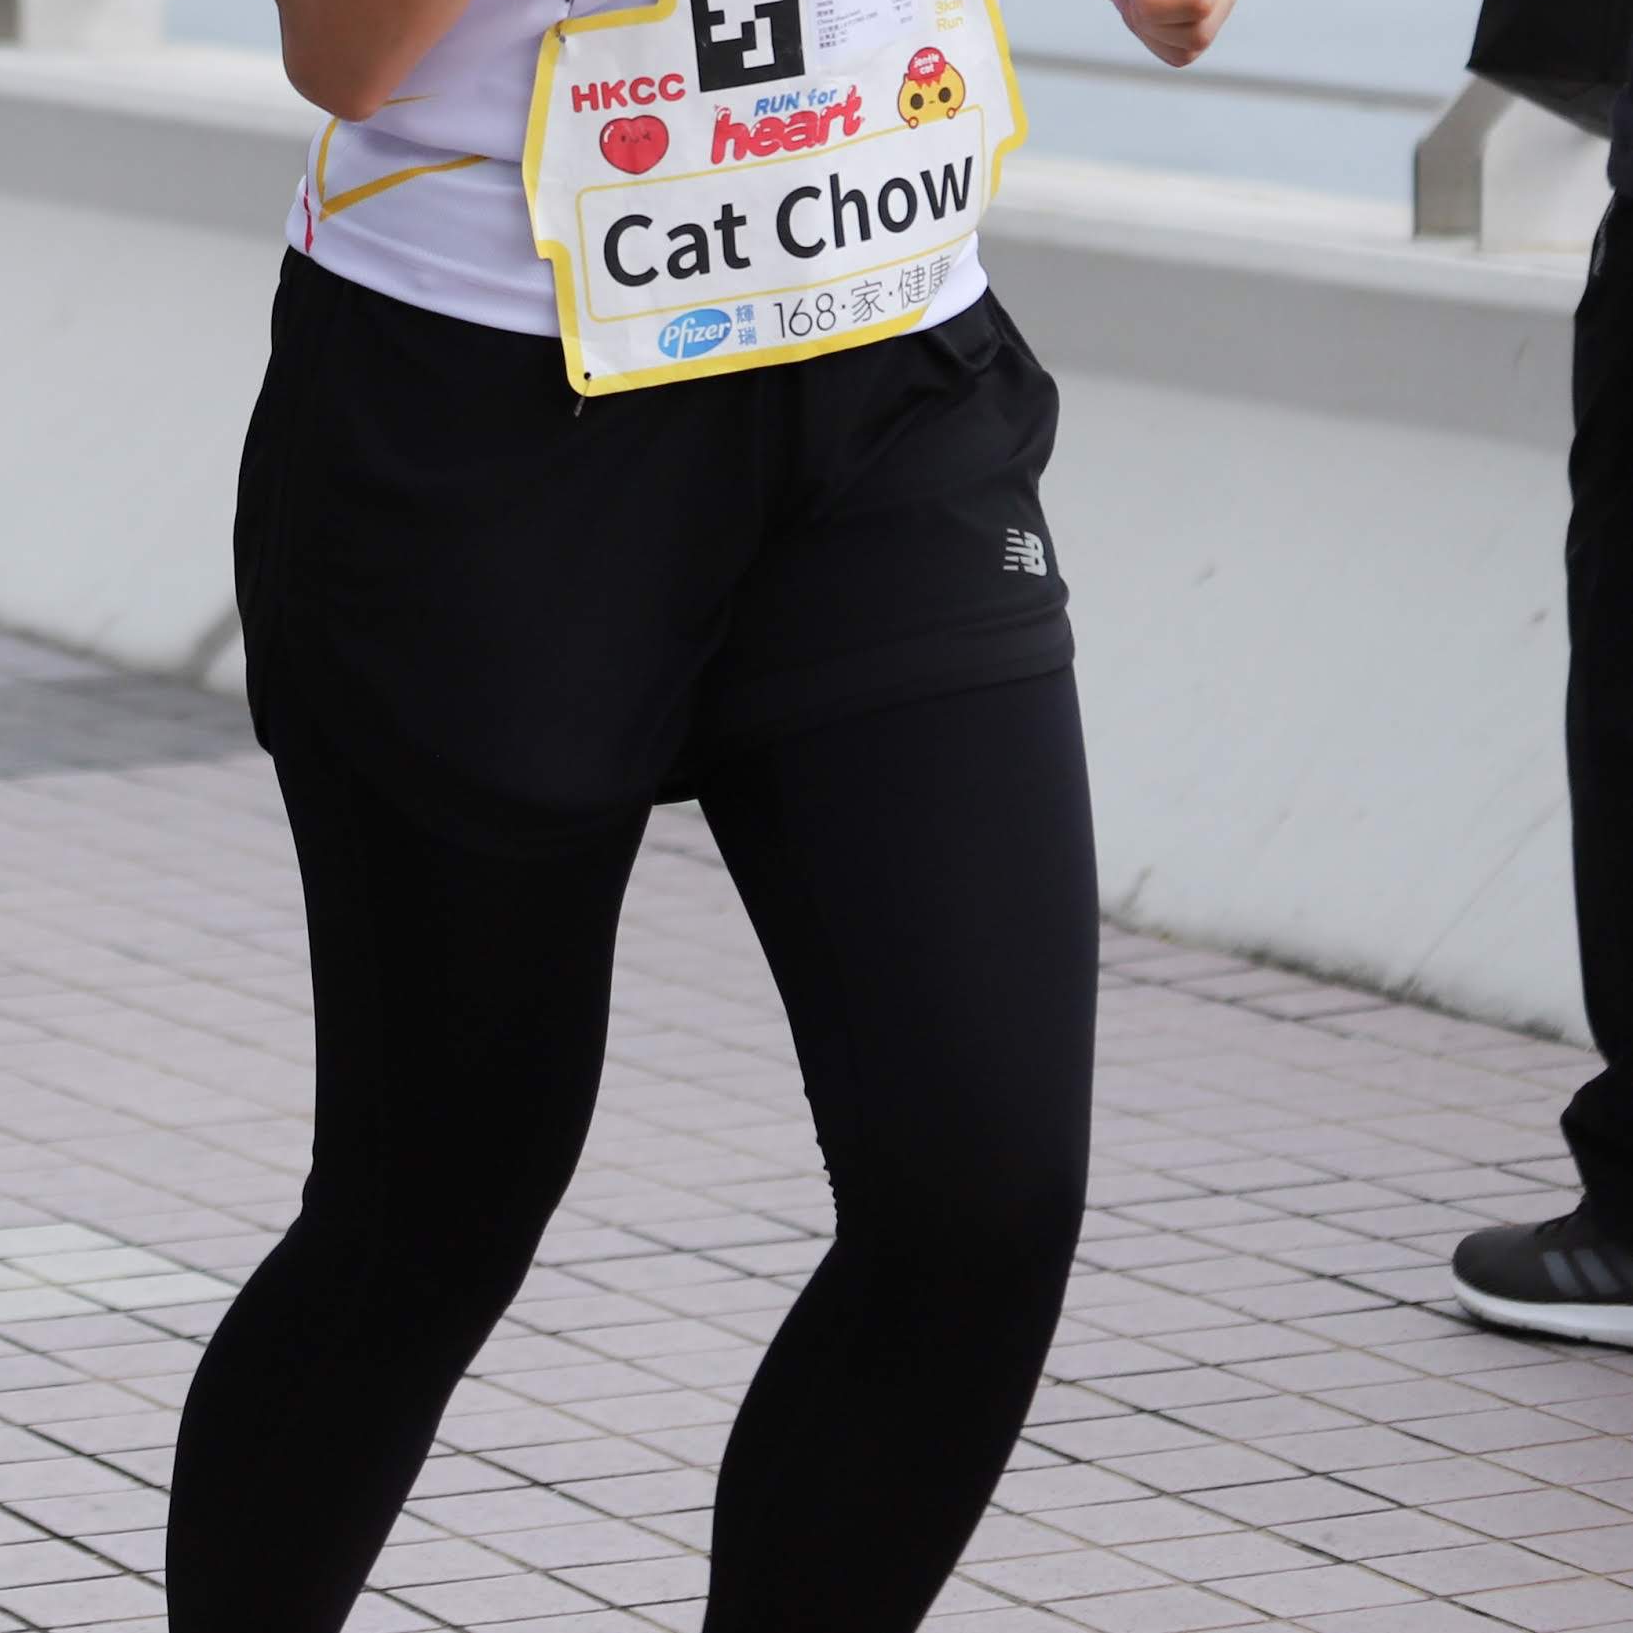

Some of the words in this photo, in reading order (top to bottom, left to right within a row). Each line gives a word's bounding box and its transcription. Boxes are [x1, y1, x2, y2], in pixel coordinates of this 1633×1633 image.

[571, 73, 686, 113] HKCC
[753, 94, 802, 117] RUN
[807, 88, 838, 109] for
[711, 85, 862, 165] heart
[603, 203, 751, 287] Cat
[776, 156, 973, 259] Chow
[663, 317, 731, 359] Pfizer
